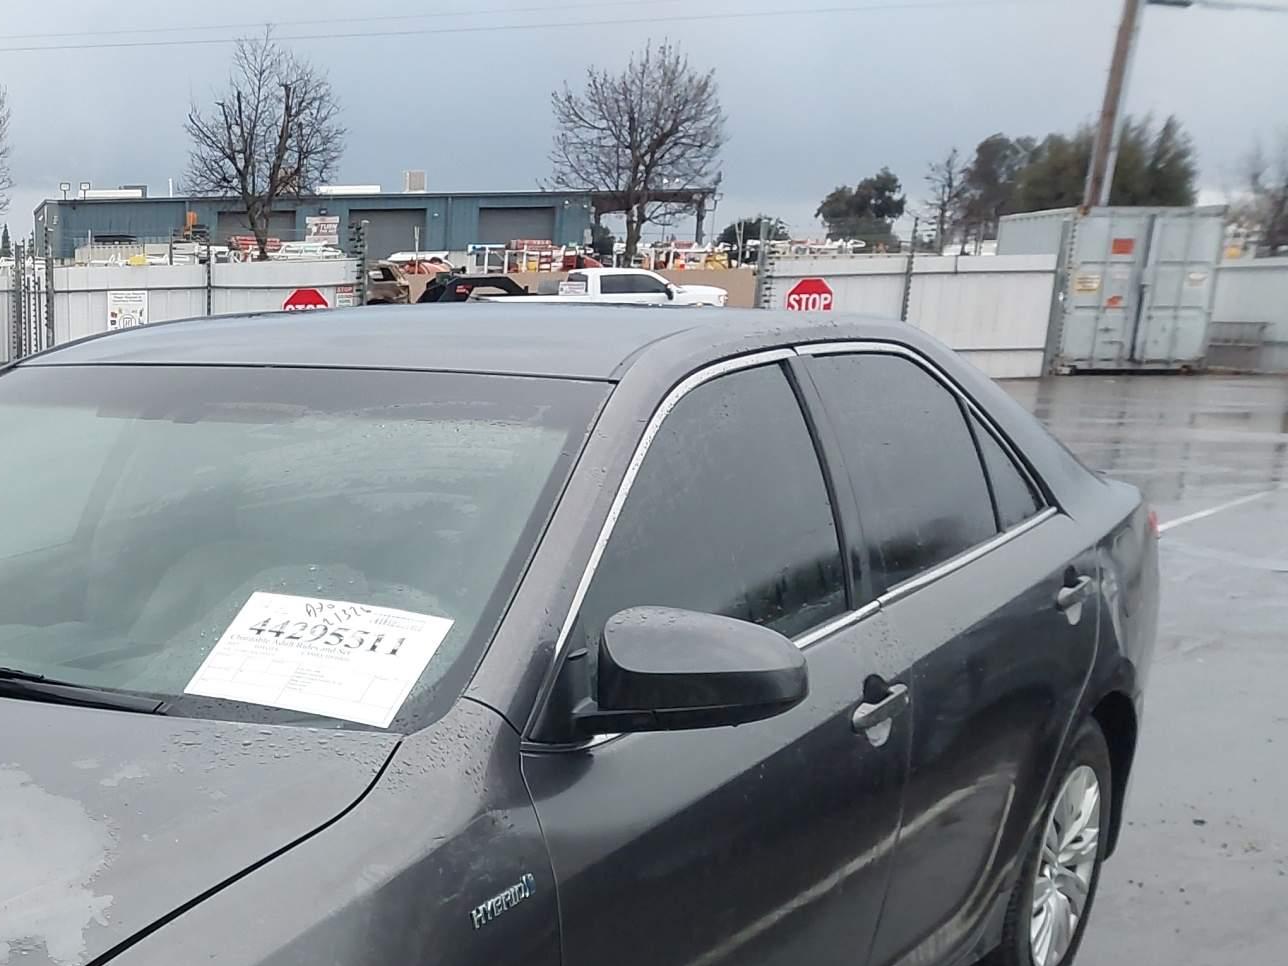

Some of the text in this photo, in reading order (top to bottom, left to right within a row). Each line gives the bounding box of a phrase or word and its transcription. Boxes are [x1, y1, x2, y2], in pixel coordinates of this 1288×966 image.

[787, 293, 832, 312] STOP
[248, 617, 406, 656] 44295511
[471, 881, 526, 929] HYBRID
